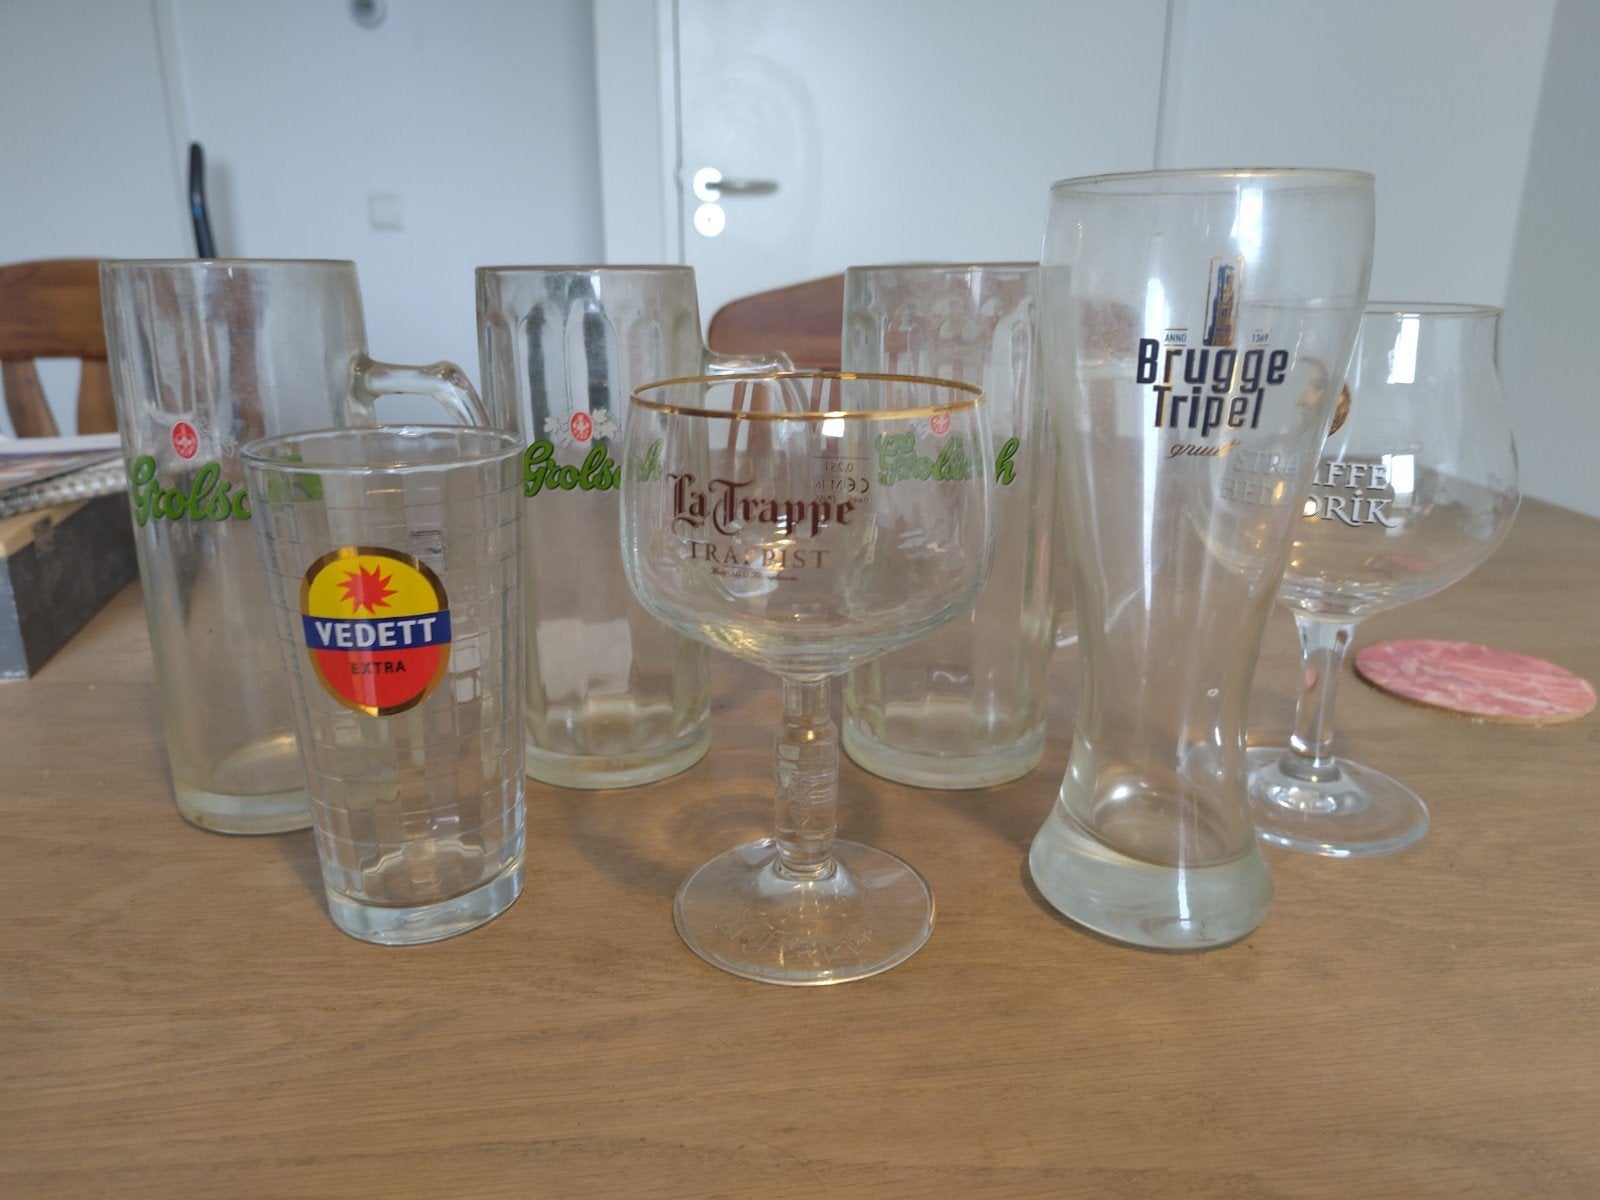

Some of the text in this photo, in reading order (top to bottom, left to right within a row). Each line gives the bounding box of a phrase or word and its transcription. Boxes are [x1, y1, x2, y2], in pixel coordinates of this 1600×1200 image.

[1165, 333, 1187, 343] ANNO
[1136, 338, 1289, 394] Brugge
[1153, 385, 1264, 437] Tripel
[131, 455, 252, 526] Grolsc
[666, 473, 856, 537] La Trappe
[314, 616, 437, 648] VEDETT
[351, 661, 406, 675] EXTRA
